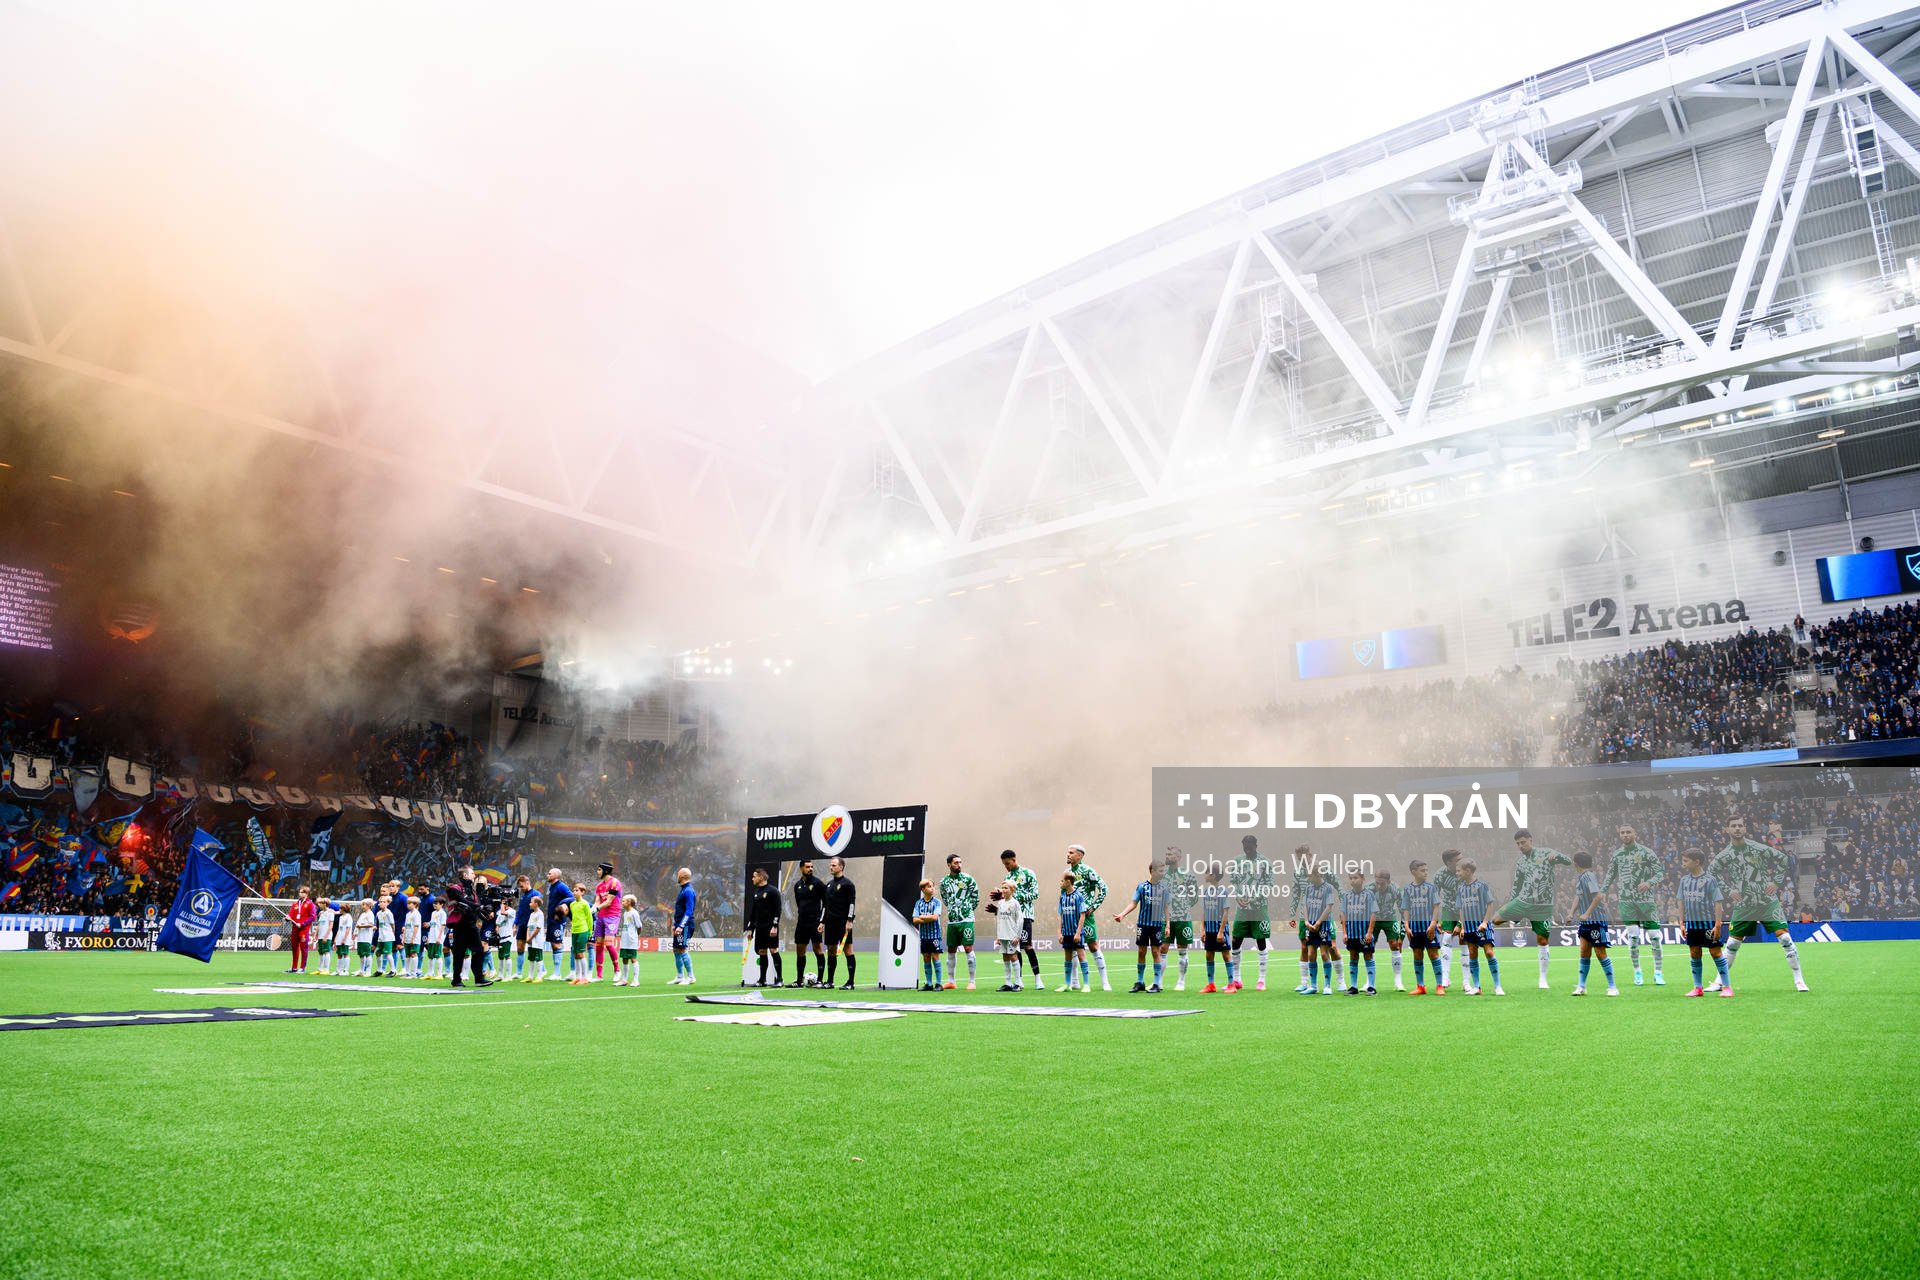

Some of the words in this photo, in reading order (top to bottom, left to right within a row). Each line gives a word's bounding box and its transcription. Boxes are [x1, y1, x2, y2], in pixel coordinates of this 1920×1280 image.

[1507, 598, 1621, 648] TELE2
[1630, 599, 1750, 635] Arena
[18, 631, 52, 643] Karlsson
[755, 825, 803, 841] UNIBET
[863, 816, 915, 834] UNIBET
[181, 922, 202, 934] UNIBET
[64, 936, 148, 949] FXORO.COM
[892, 934, 907, 956] U
